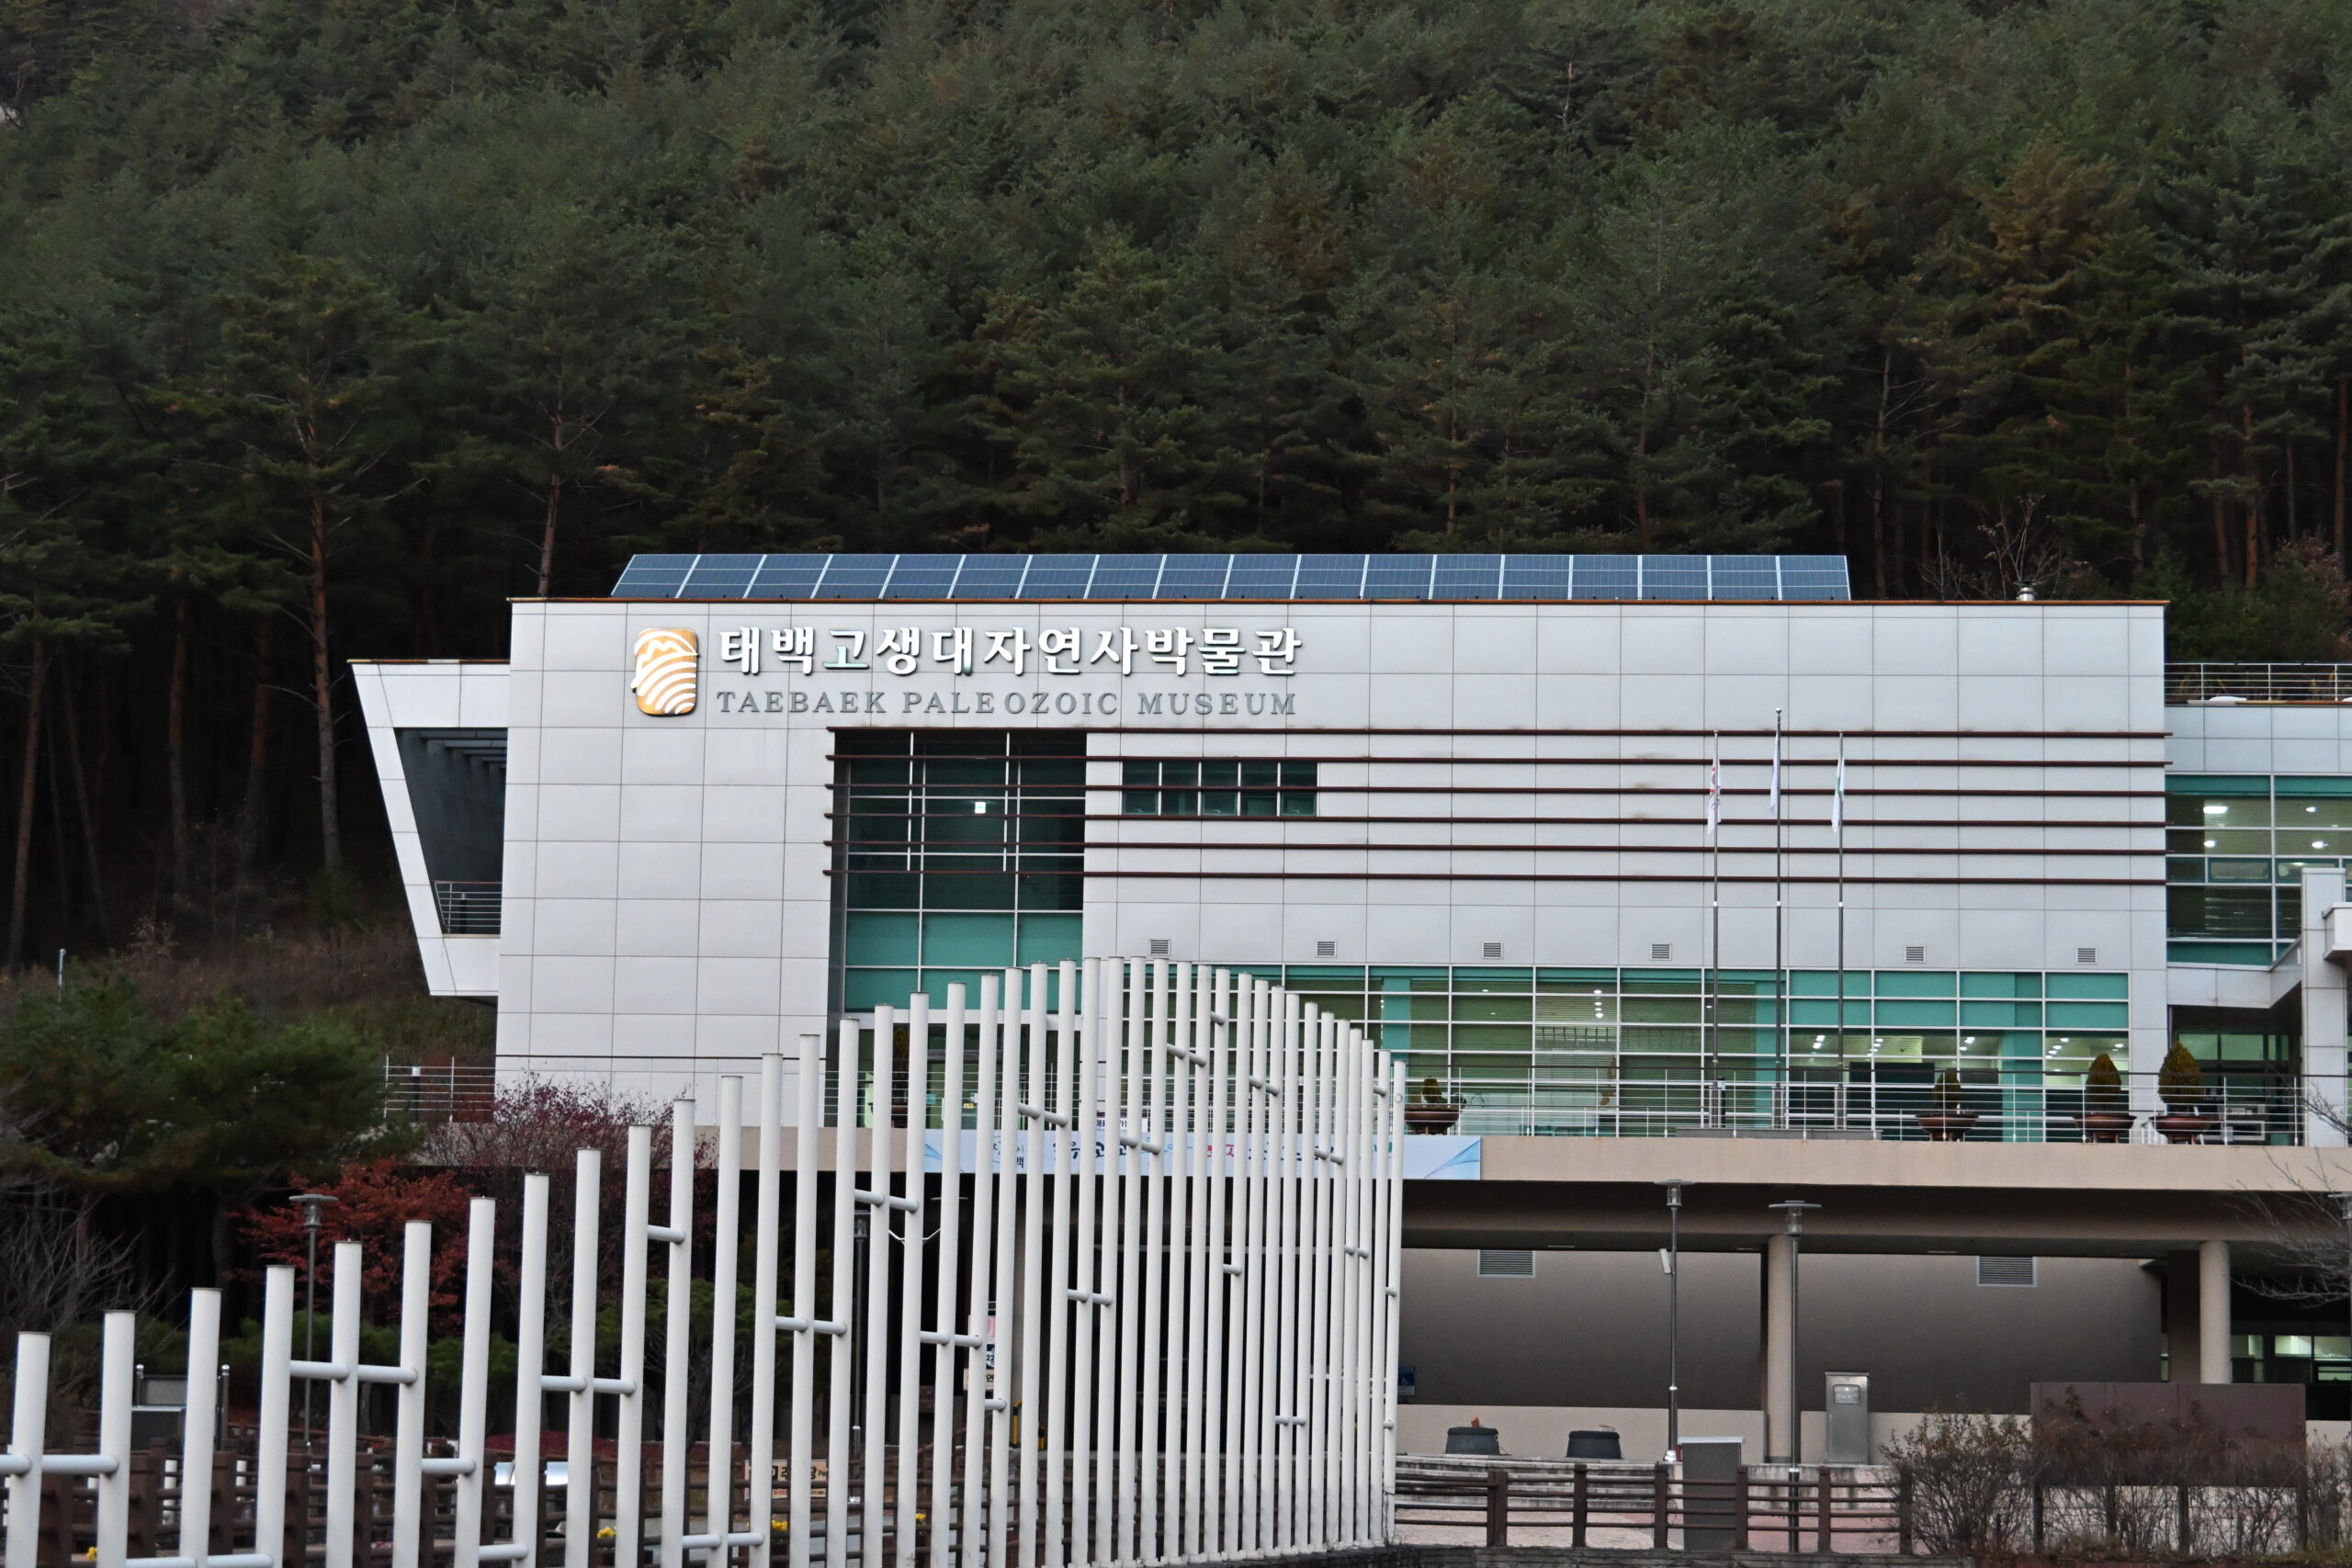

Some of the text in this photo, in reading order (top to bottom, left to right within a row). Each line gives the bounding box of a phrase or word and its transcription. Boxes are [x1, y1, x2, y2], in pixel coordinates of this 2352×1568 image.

[719, 626, 1303, 675] 태백고생대자연사박물관
[717, 691, 1297, 716] TAEBAEK PALEOZOIC MUSEUM
